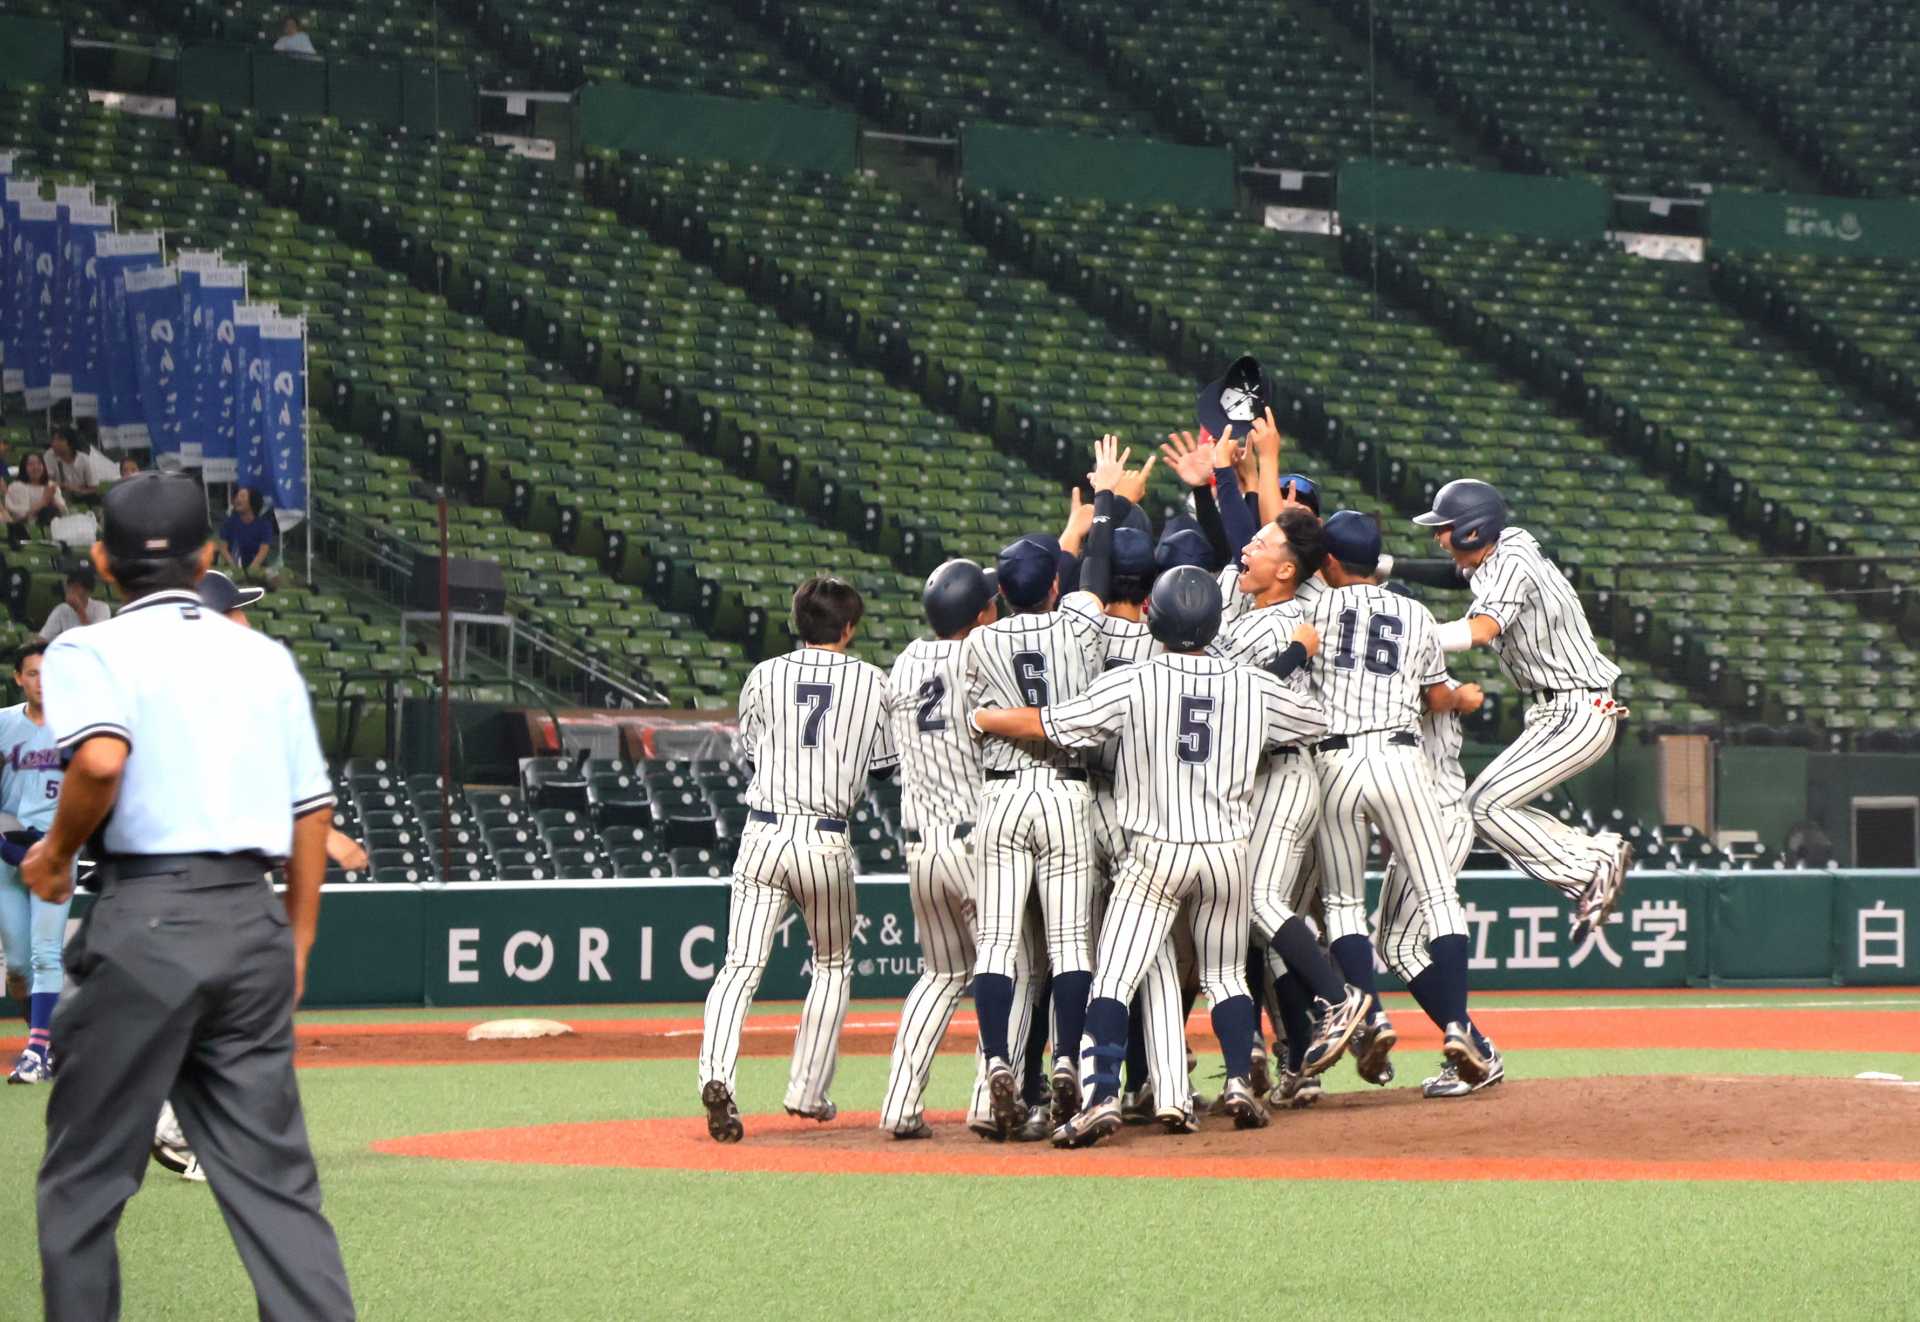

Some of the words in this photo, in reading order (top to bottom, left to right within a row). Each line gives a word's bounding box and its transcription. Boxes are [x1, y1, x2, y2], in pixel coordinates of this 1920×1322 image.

[1333, 607, 1405, 678] 16
[917, 673, 946, 732] 2
[1010, 651, 1050, 708] 6
[794, 681, 834, 748] 7
[1175, 693, 1216, 765] 5
[1857, 900, 1905, 969] 白
